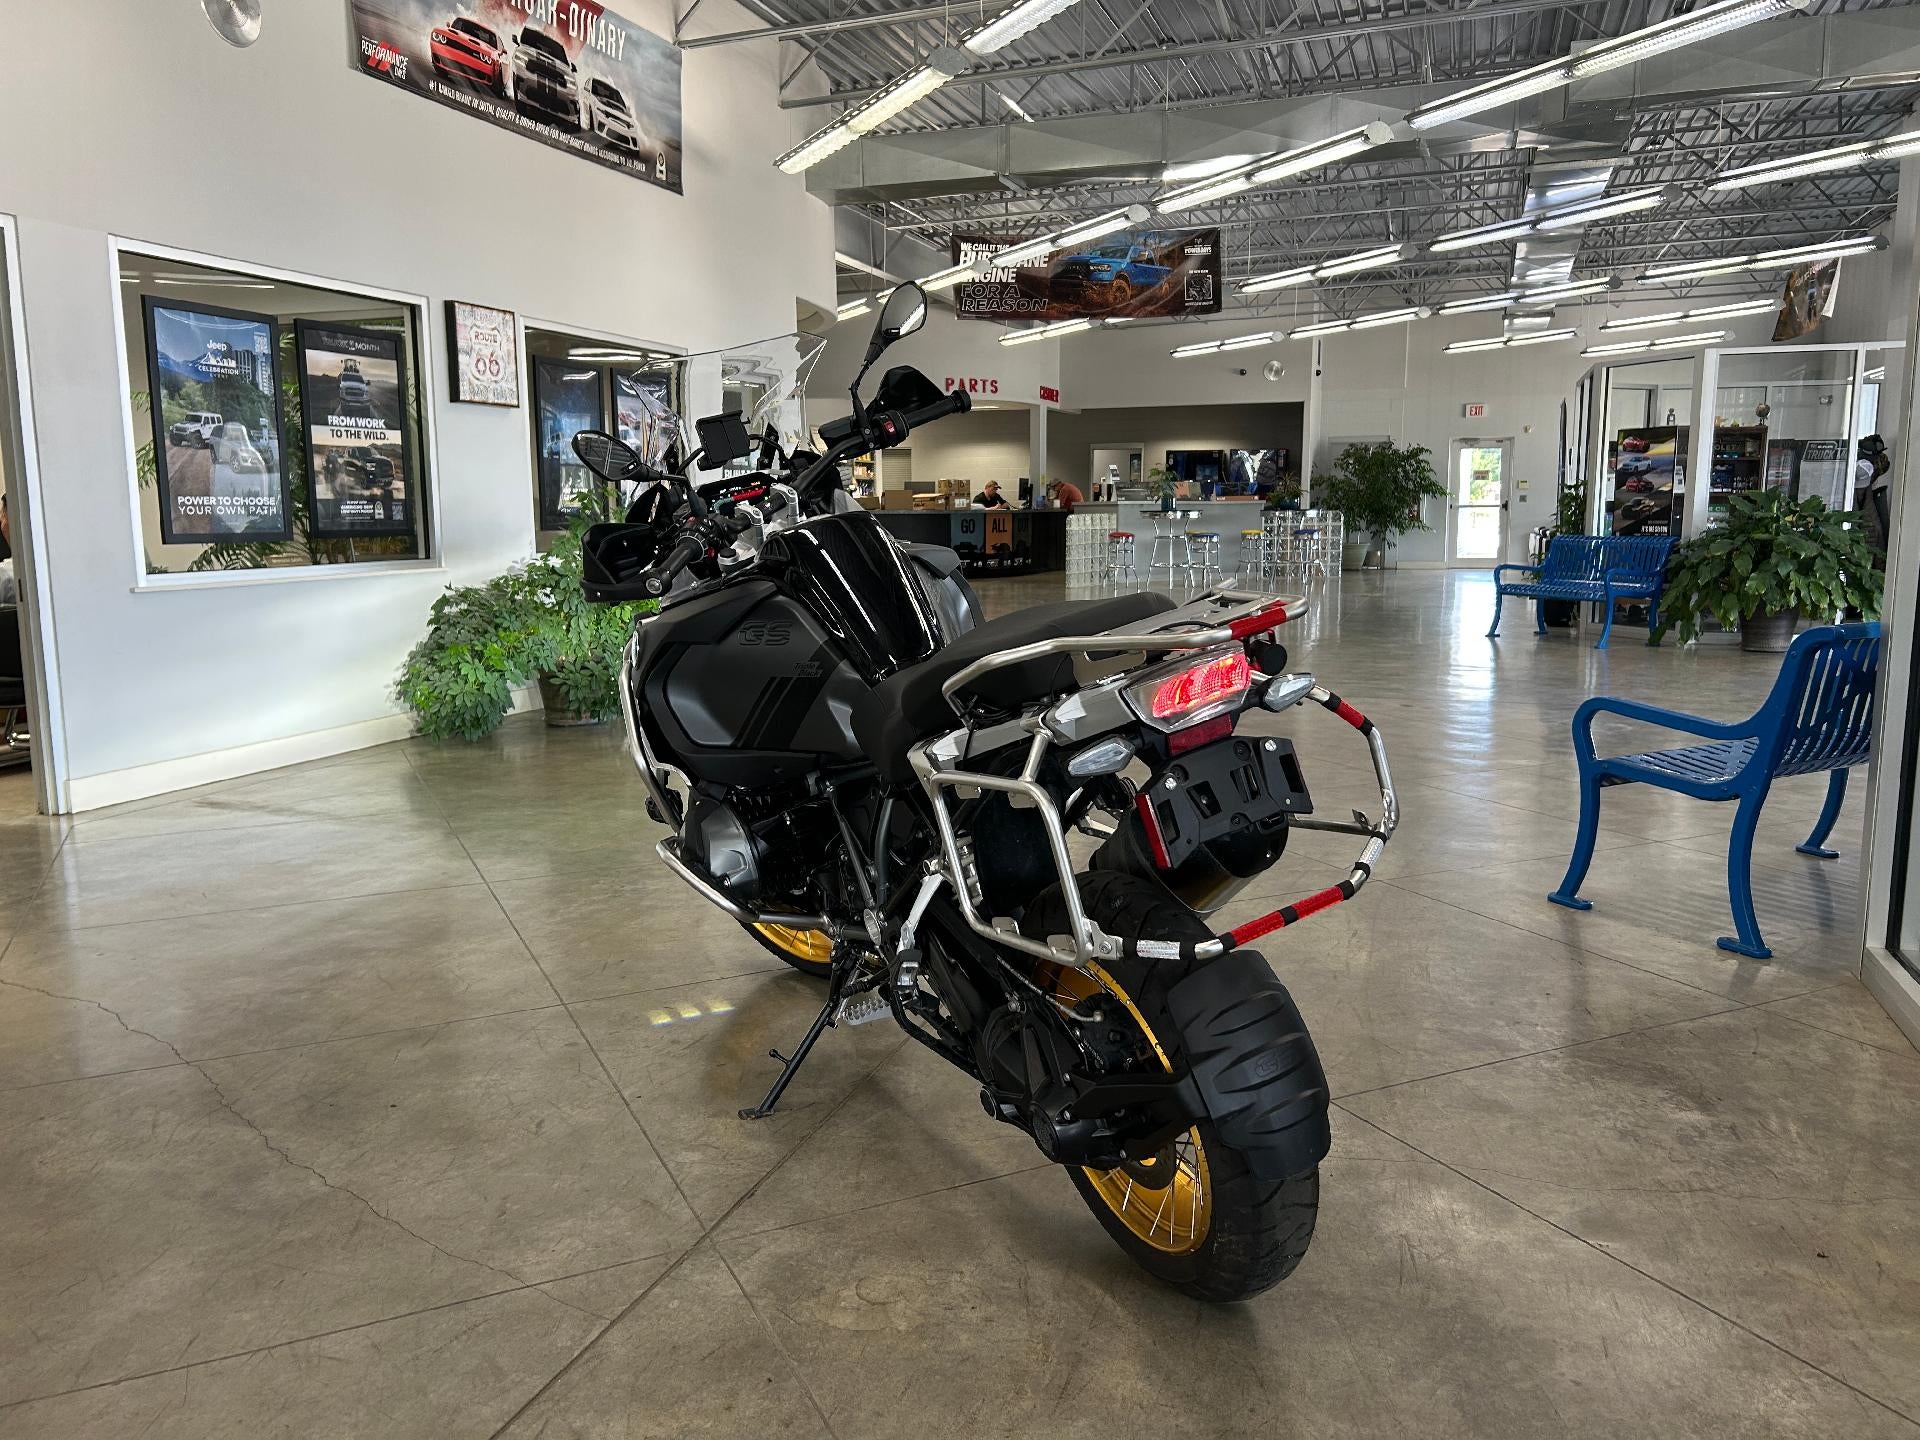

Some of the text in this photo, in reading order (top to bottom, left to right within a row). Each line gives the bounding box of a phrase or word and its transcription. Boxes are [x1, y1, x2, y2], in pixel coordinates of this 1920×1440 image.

[361, 40, 409, 67] PERFORMANCE
[960, 242, 972, 251] WE
[973, 243, 989, 251] CALL
[964, 267, 1018, 283] NGINE
[961, 283, 1021, 298] FOR A
[961, 298, 1049, 313] REASON
[474, 330, 498, 344] ROUTE
[206, 339, 228, 351] Jeep
[355, 341, 380, 352] MONTH
[198, 365, 239, 376] CELEBRATION
[945, 377, 999, 394] PARTS
[1469, 405, 1484, 417] EXIT
[328, 414, 386, 429] FROM WORK
[330, 428, 389, 441] TO THE WILD.
[1807, 448, 1836, 460] TRUCK
[177, 495, 275, 506] POWER TO CHOOSE
[178, 505, 277, 516] YOUR OWN PATH
[961, 518, 975, 534] GO
[991, 517, 1008, 533] ALL
[737, 620, 793, 647] GS
